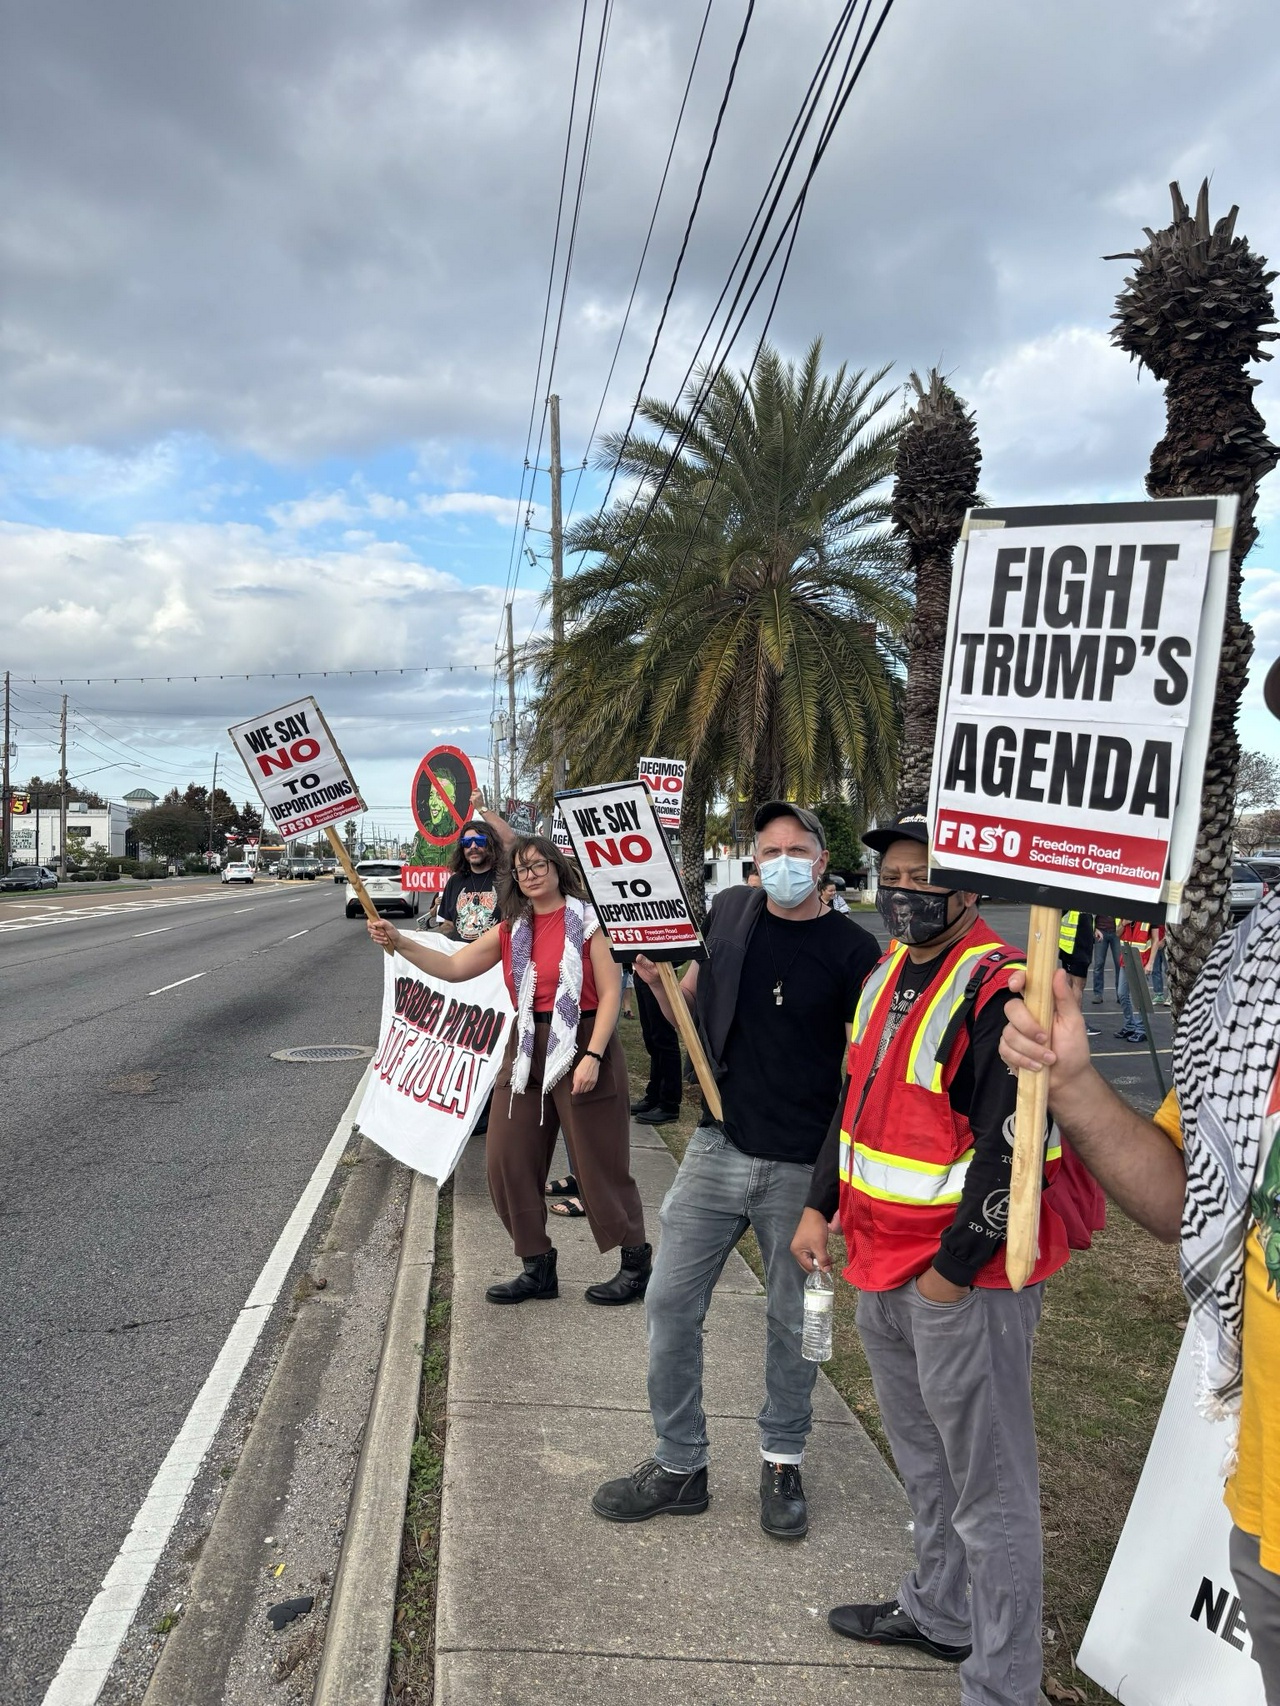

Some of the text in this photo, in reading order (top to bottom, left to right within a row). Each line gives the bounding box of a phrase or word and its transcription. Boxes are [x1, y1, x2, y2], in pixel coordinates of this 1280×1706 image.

[989, 543, 1180, 630] FIGHT
[960, 633, 1192, 706] TRUMP'S
[244, 711, 310, 754] WE SAY
[256, 738, 321, 777] NO
[640, 761, 685, 777] DECIMOS
[943, 722, 1172, 819] AGENDA
[282, 773, 321, 795] TO
[640, 774, 683, 793] NO
[270, 780, 353, 821] DEPORTATIONS
[655, 796, 679, 805] LAS
[280, 817, 313, 835] FRSO
[572, 800, 642, 838] WE SAY
[584, 834, 653, 868] NO
[938, 820, 1021, 858] FRSO
[1031, 836, 1121, 861] Freedom Road
[1029, 850, 1160, 882] Socialist Organization
[406, 871, 435, 889] LOCK
[611, 879, 652, 899] TO
[599, 899, 688, 923] DEPORTATIONS
[610, 927, 643, 943] FRSO
[644, 927, 678, 936] Freedom Road
[645, 933, 697, 943] Socialist Organization
[968, 1221, 983, 1233] TO
